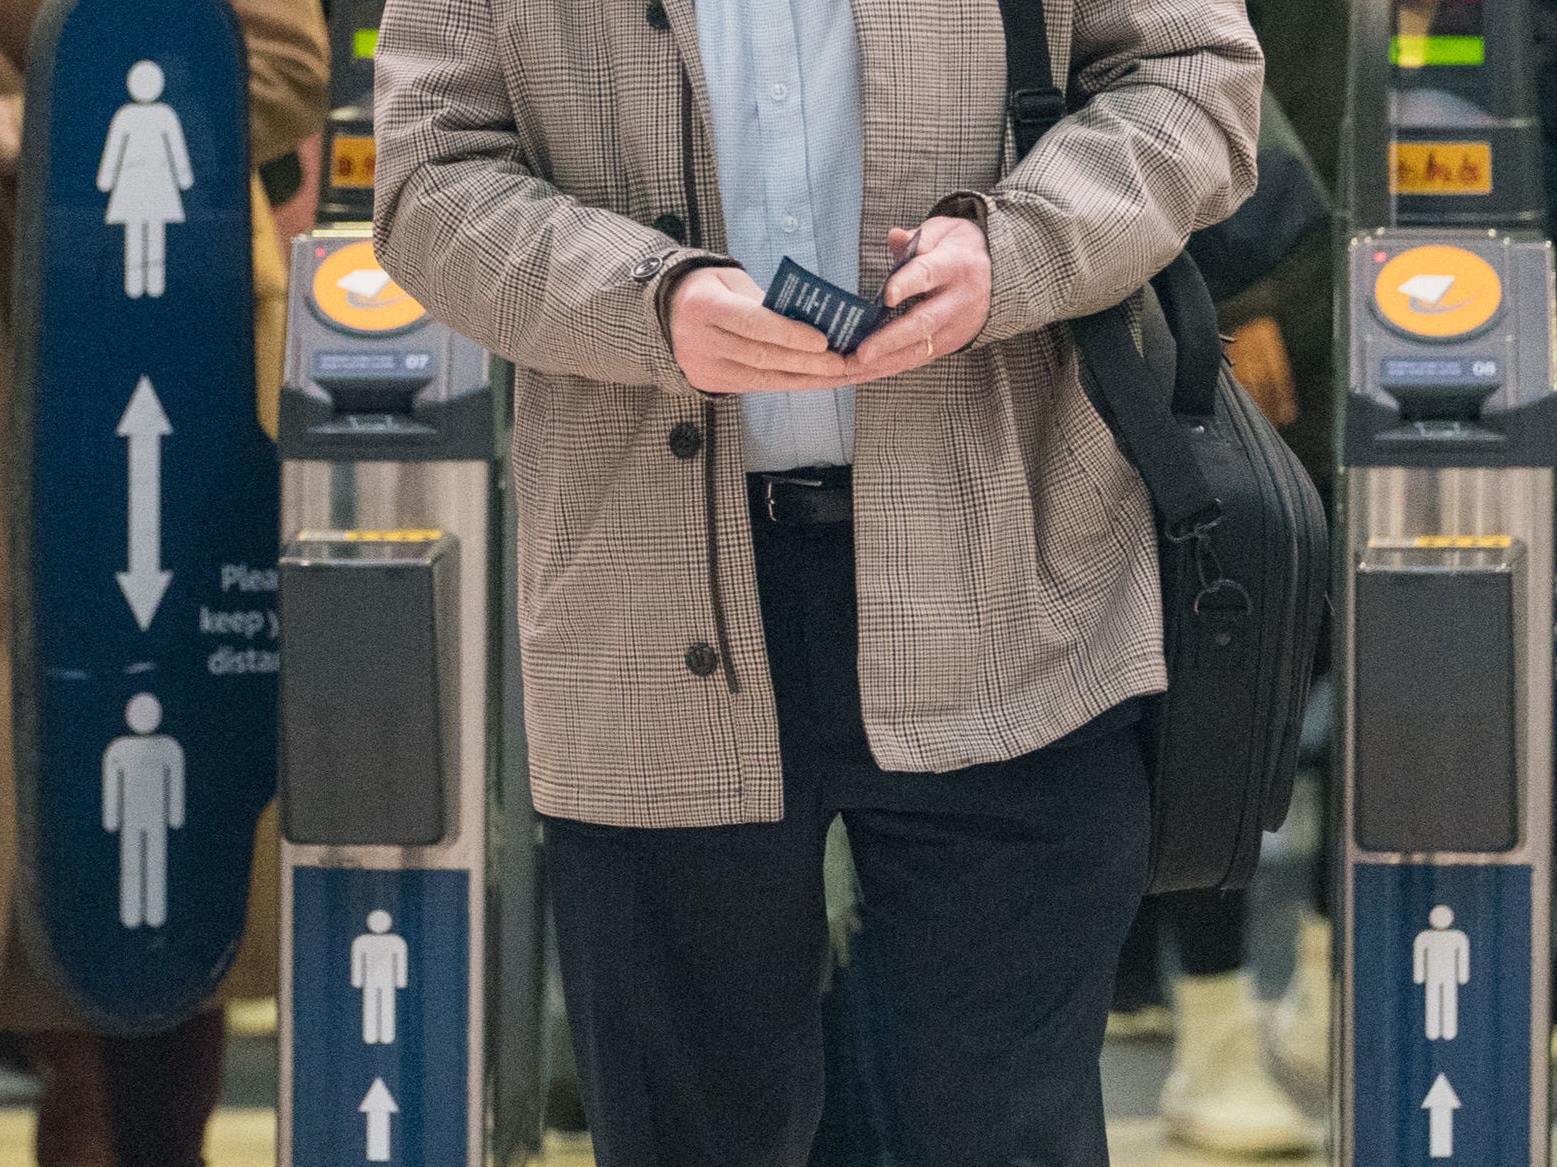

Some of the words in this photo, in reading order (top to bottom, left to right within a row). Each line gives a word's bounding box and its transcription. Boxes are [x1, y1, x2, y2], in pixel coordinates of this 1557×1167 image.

[220, 563, 279, 593] Plea
[199, 606, 265, 639] keep
[207, 645, 281, 675] dista
